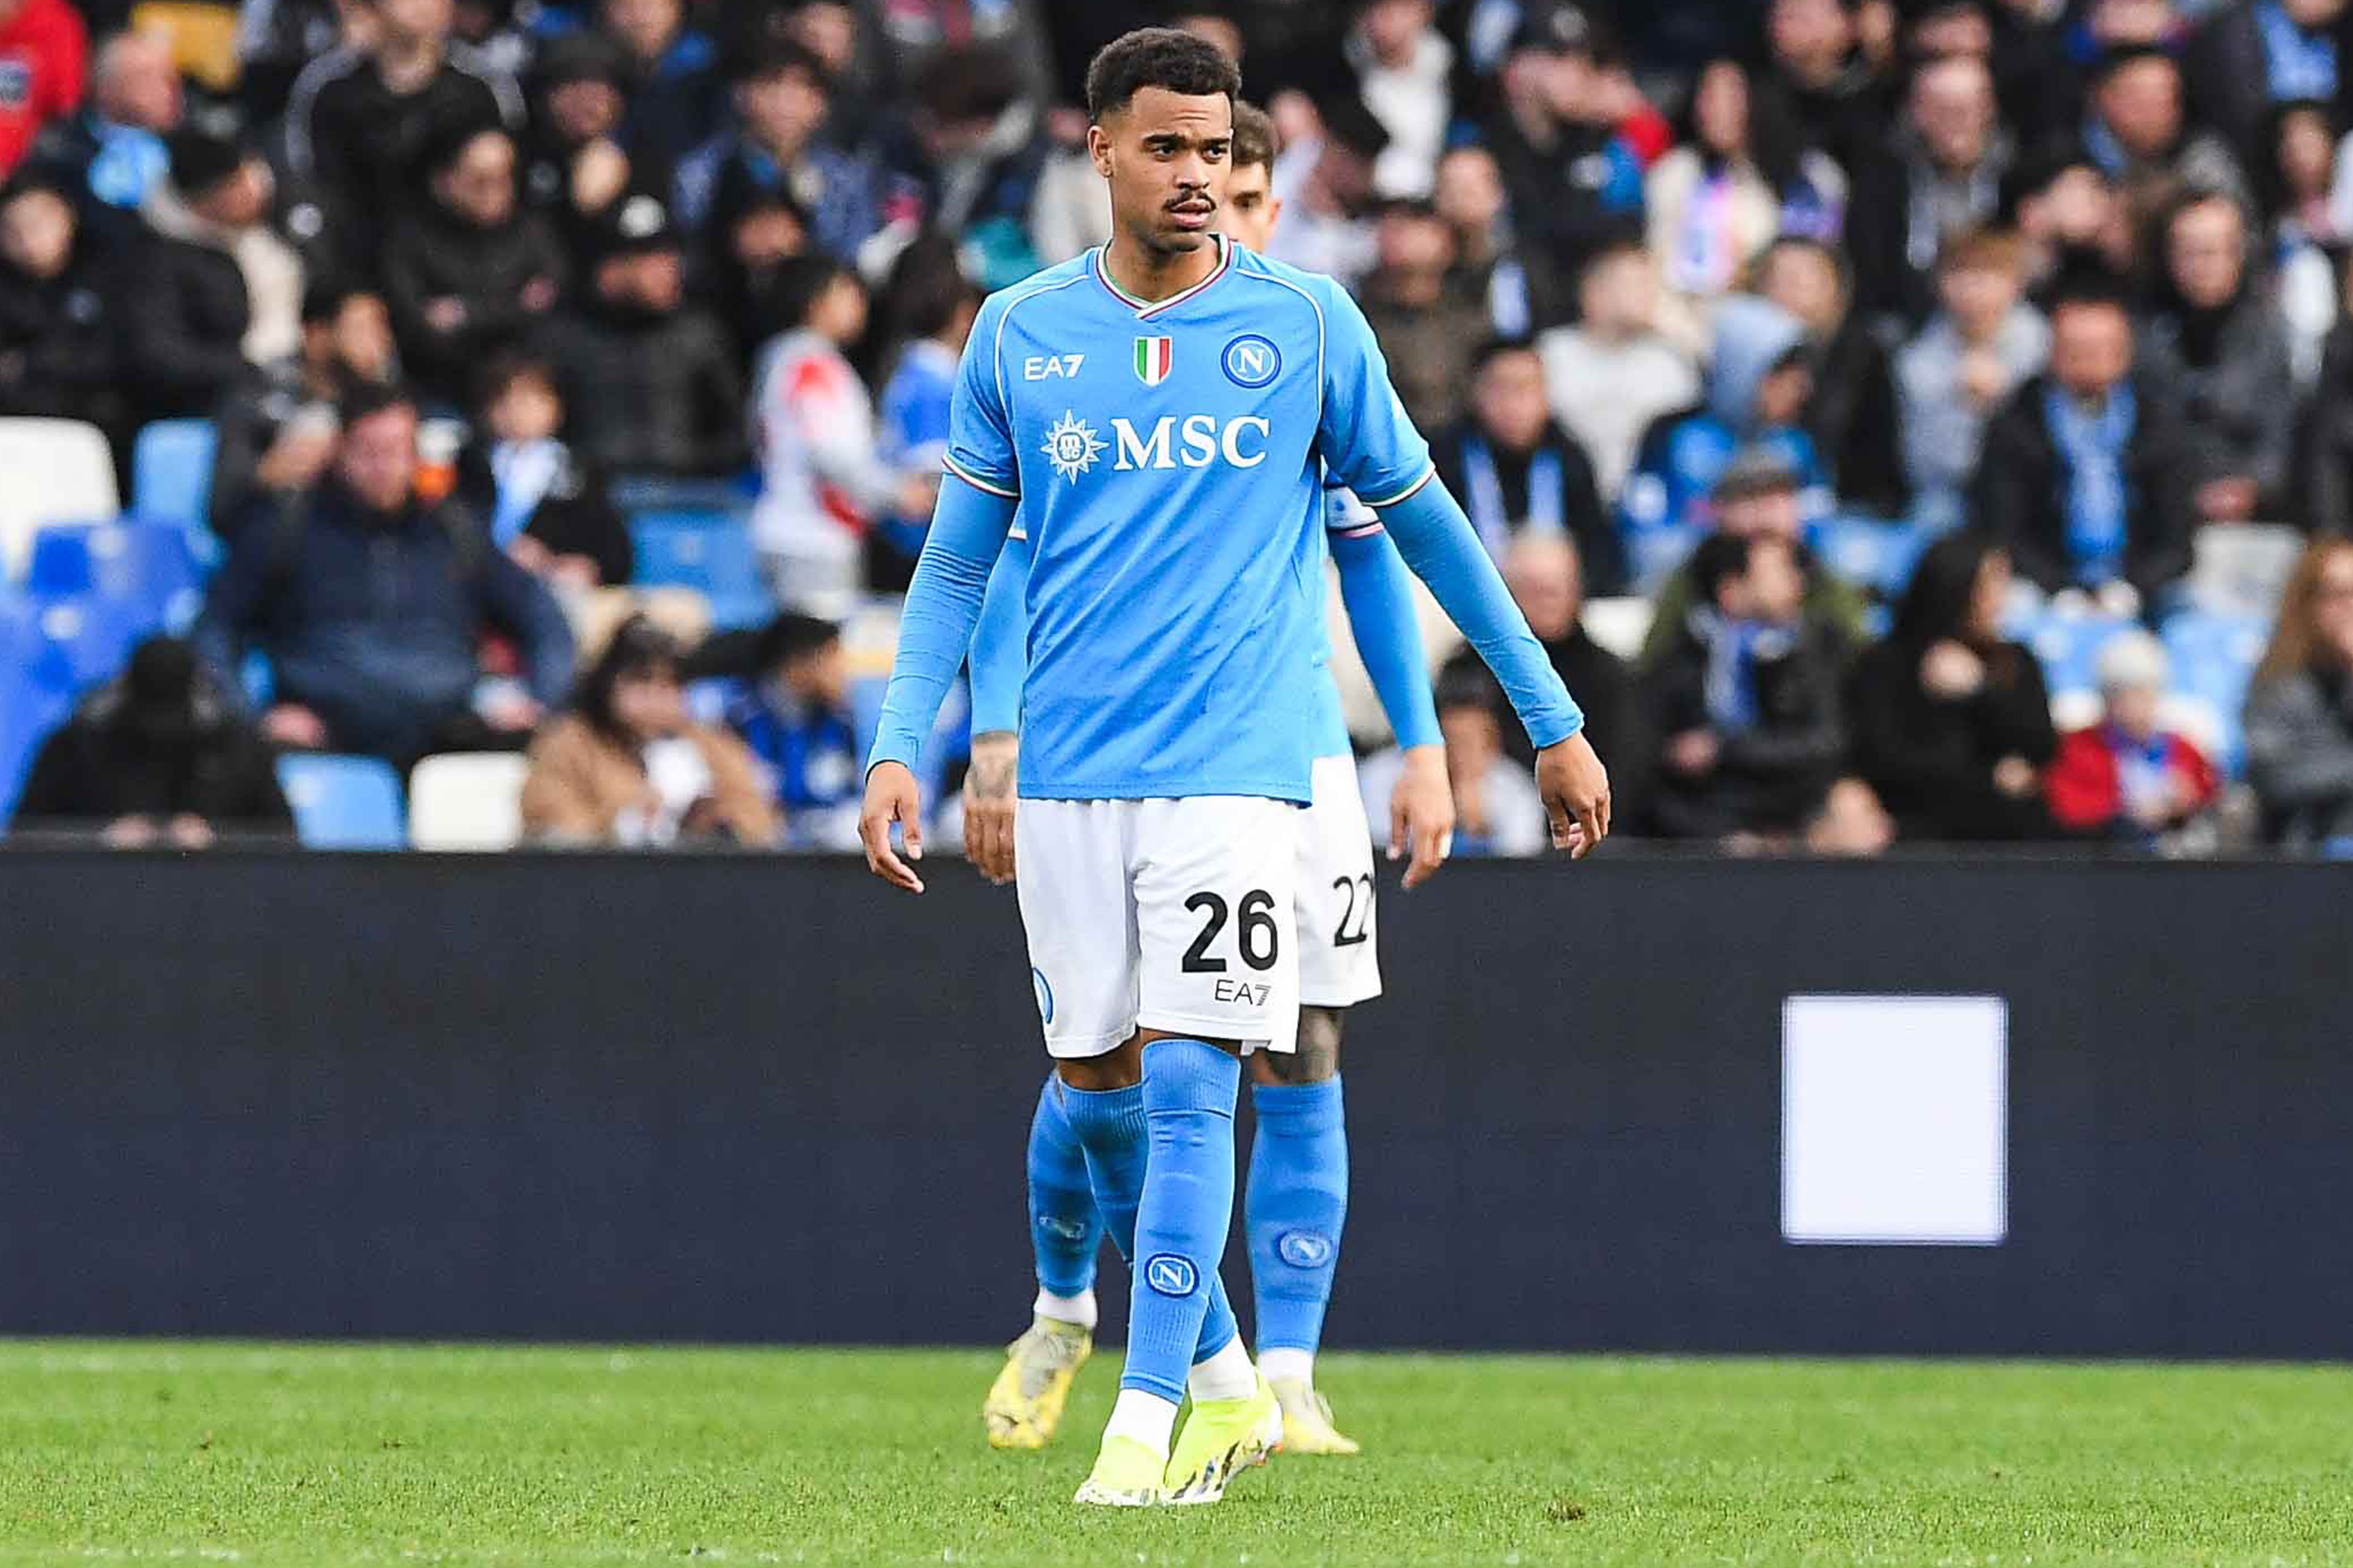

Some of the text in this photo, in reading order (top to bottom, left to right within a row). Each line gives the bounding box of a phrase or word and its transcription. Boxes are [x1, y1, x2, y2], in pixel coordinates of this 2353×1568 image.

[1025, 354, 1085, 381] EA7
[1238, 347, 1264, 374] N
[1110, 414, 1269, 471] MSC
[1182, 889, 1278, 973] 26
[1215, 978, 1272, 1006] EA7
[1156, 1263, 1183, 1288] N
